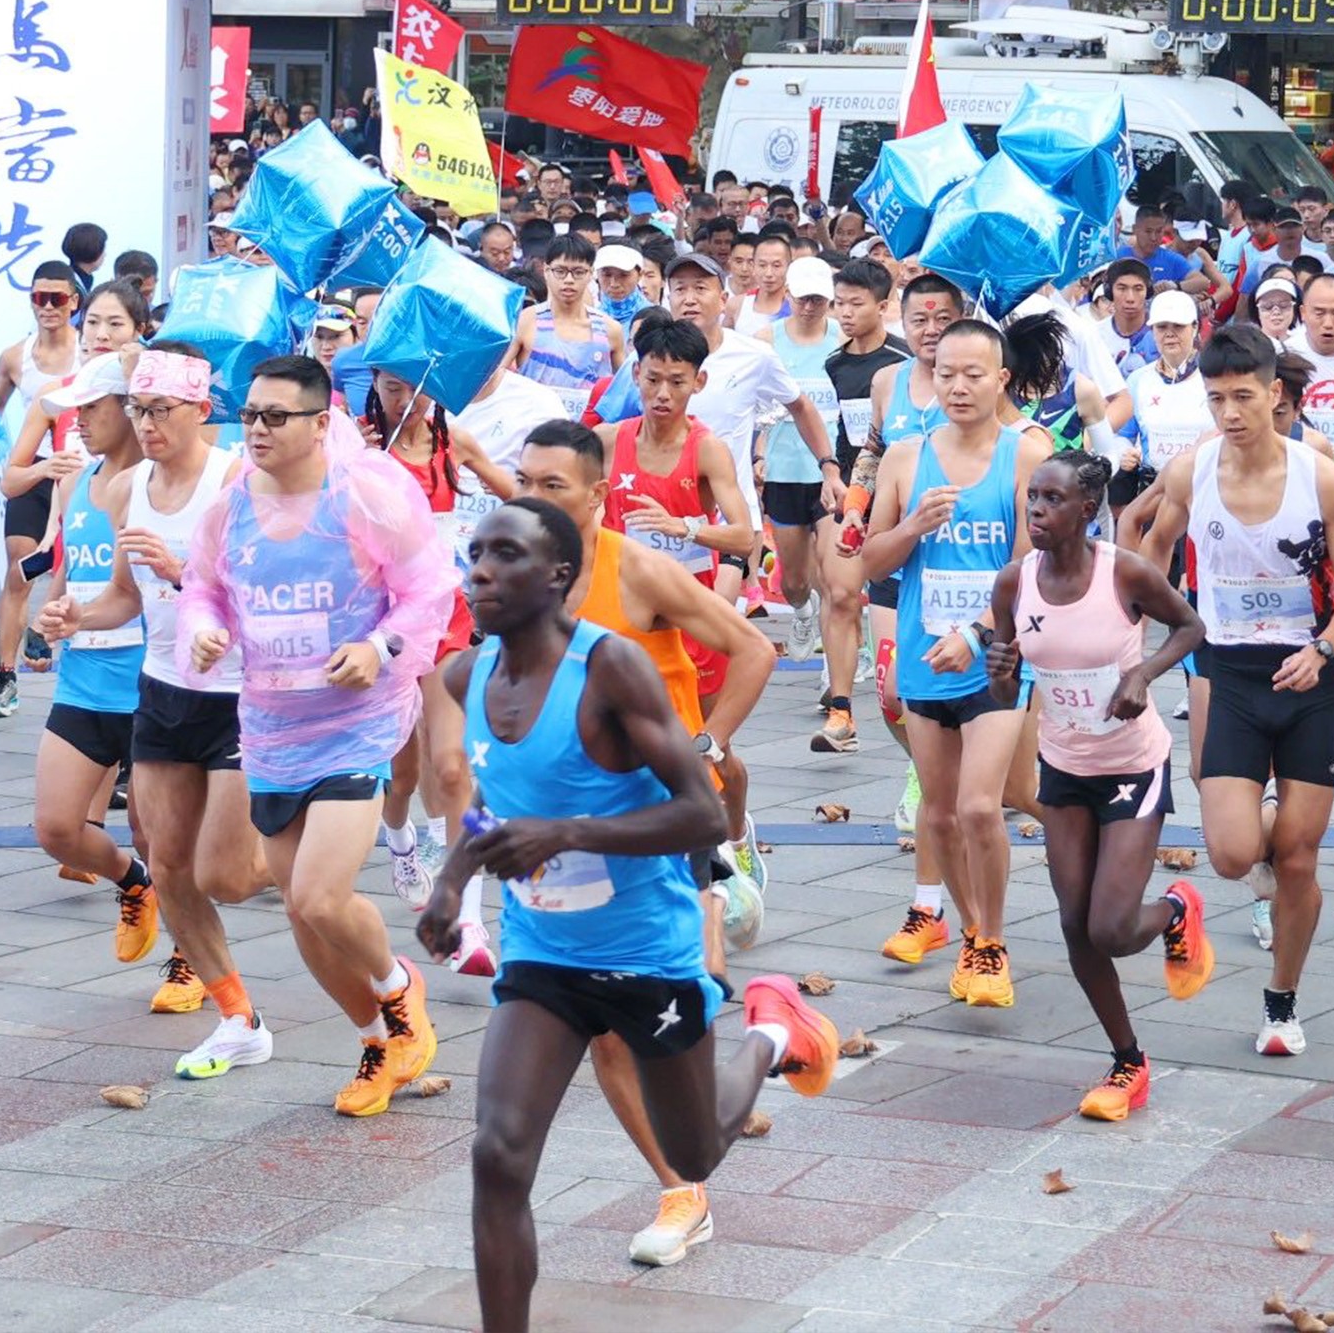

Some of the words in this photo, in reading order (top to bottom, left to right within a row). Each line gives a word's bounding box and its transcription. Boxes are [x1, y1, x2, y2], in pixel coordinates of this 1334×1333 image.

[810, 95, 900, 112] METEOROLOGI
[882, 200, 905, 236] 2:15
[372, 220, 402, 259] 2:00
[651, 533, 685, 552] S19
[238, 580, 335, 611] PACER
[1241, 591, 1282, 611] S09
[1052, 687, 1095, 708] S31
